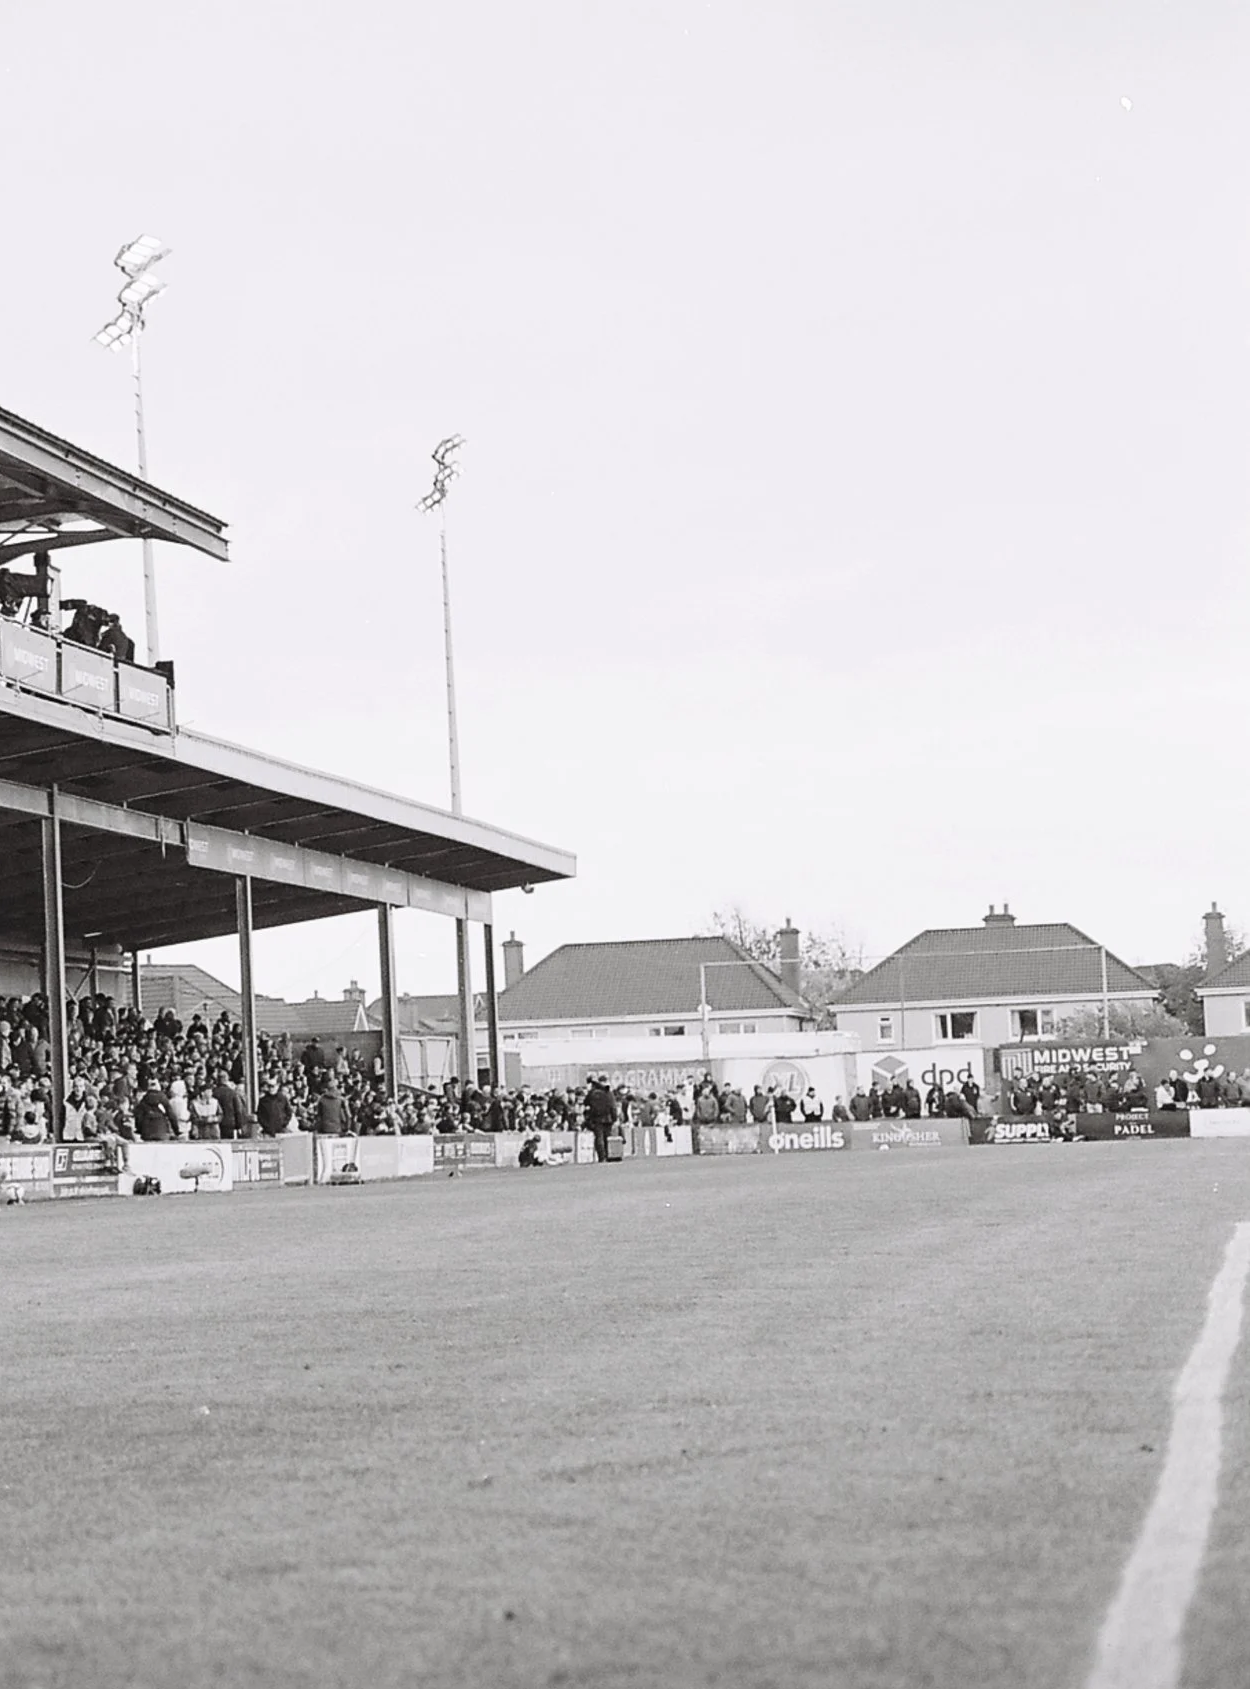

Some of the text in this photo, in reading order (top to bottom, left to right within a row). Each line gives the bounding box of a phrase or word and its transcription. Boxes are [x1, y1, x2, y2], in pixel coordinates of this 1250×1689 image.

[1034, 1046, 1130, 1064] MIDWEST
[921, 1061, 971, 1089] dpd
[1034, 1064, 1057, 1074] FIRE
[1114, 1124, 1155, 1135] PADEL
